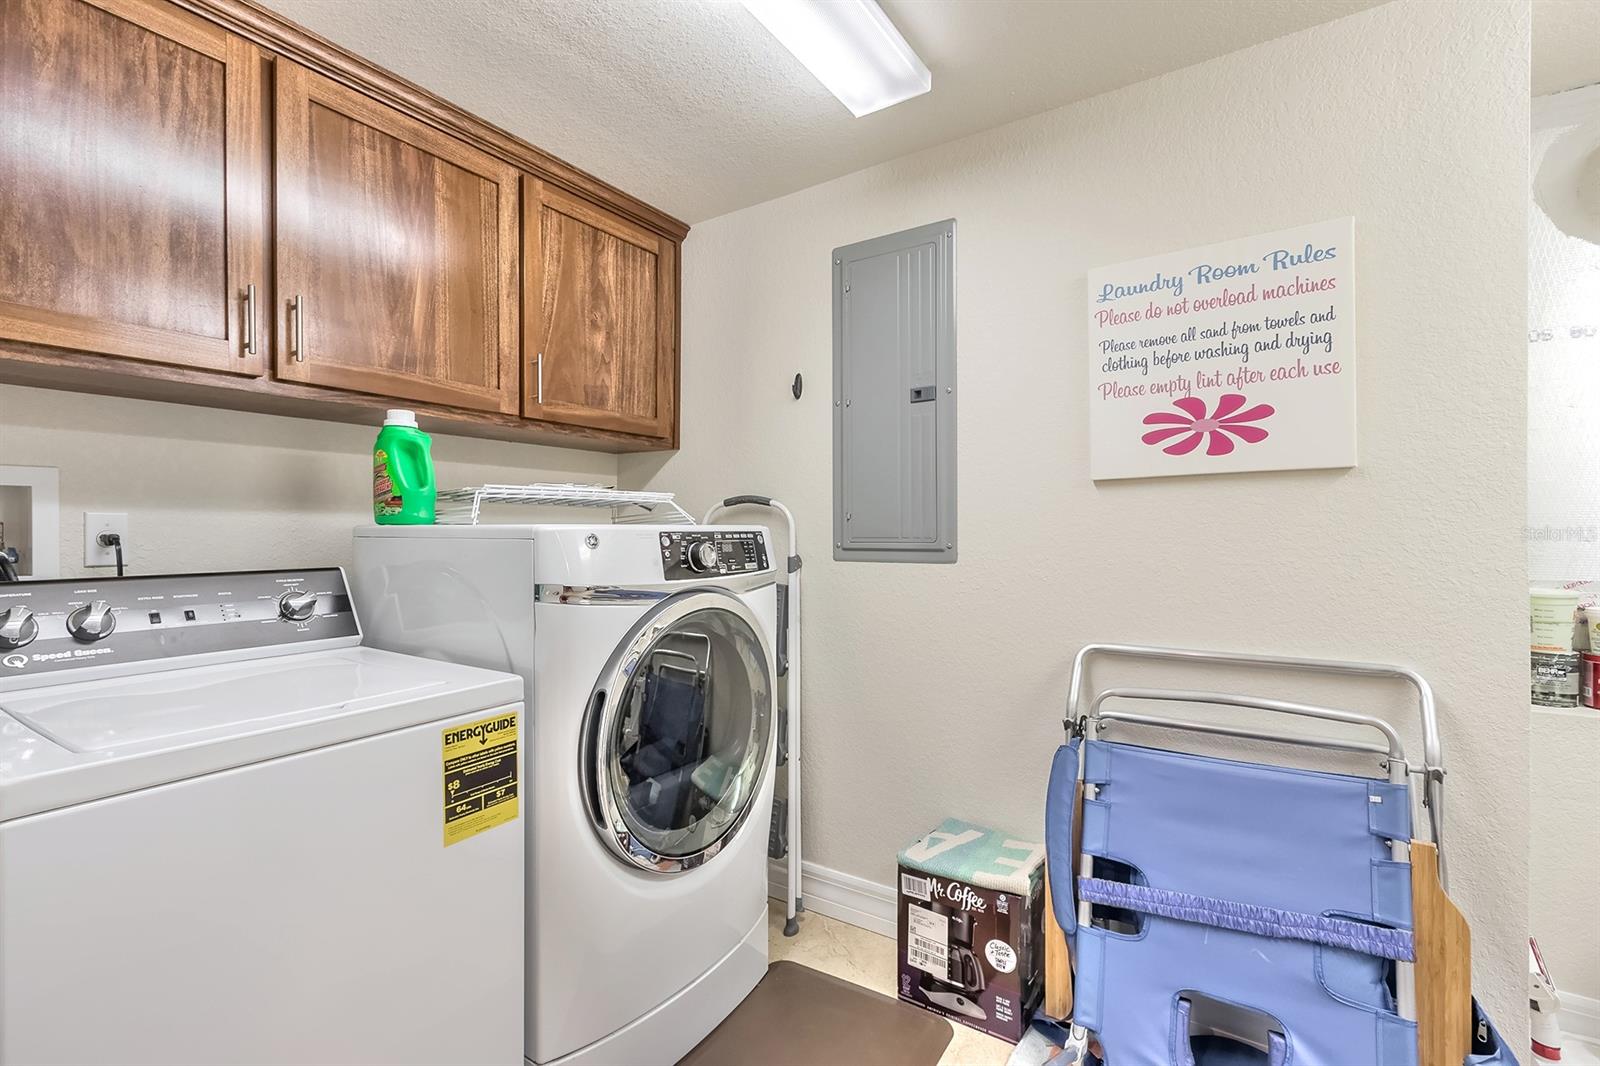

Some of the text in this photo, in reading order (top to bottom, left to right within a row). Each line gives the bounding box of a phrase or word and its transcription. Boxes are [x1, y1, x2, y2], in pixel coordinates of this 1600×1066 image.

[1096, 244, 1336, 303] Laundry Room Rules
[1094, 276, 1336, 328] Please do not overload machines
[1098, 305, 1336, 354] Please remove all sand from towels and
[1102, 331, 1332, 375] clothing before washing and drying
[1097, 358, 1342, 400] Please empty lint after each use
[32, 650, 72, 663] Speed
[444, 716, 516, 746] ENERGYGUIDE
[927, 877, 946, 899] Mr.
[946, 882, 987, 911] Coffee
